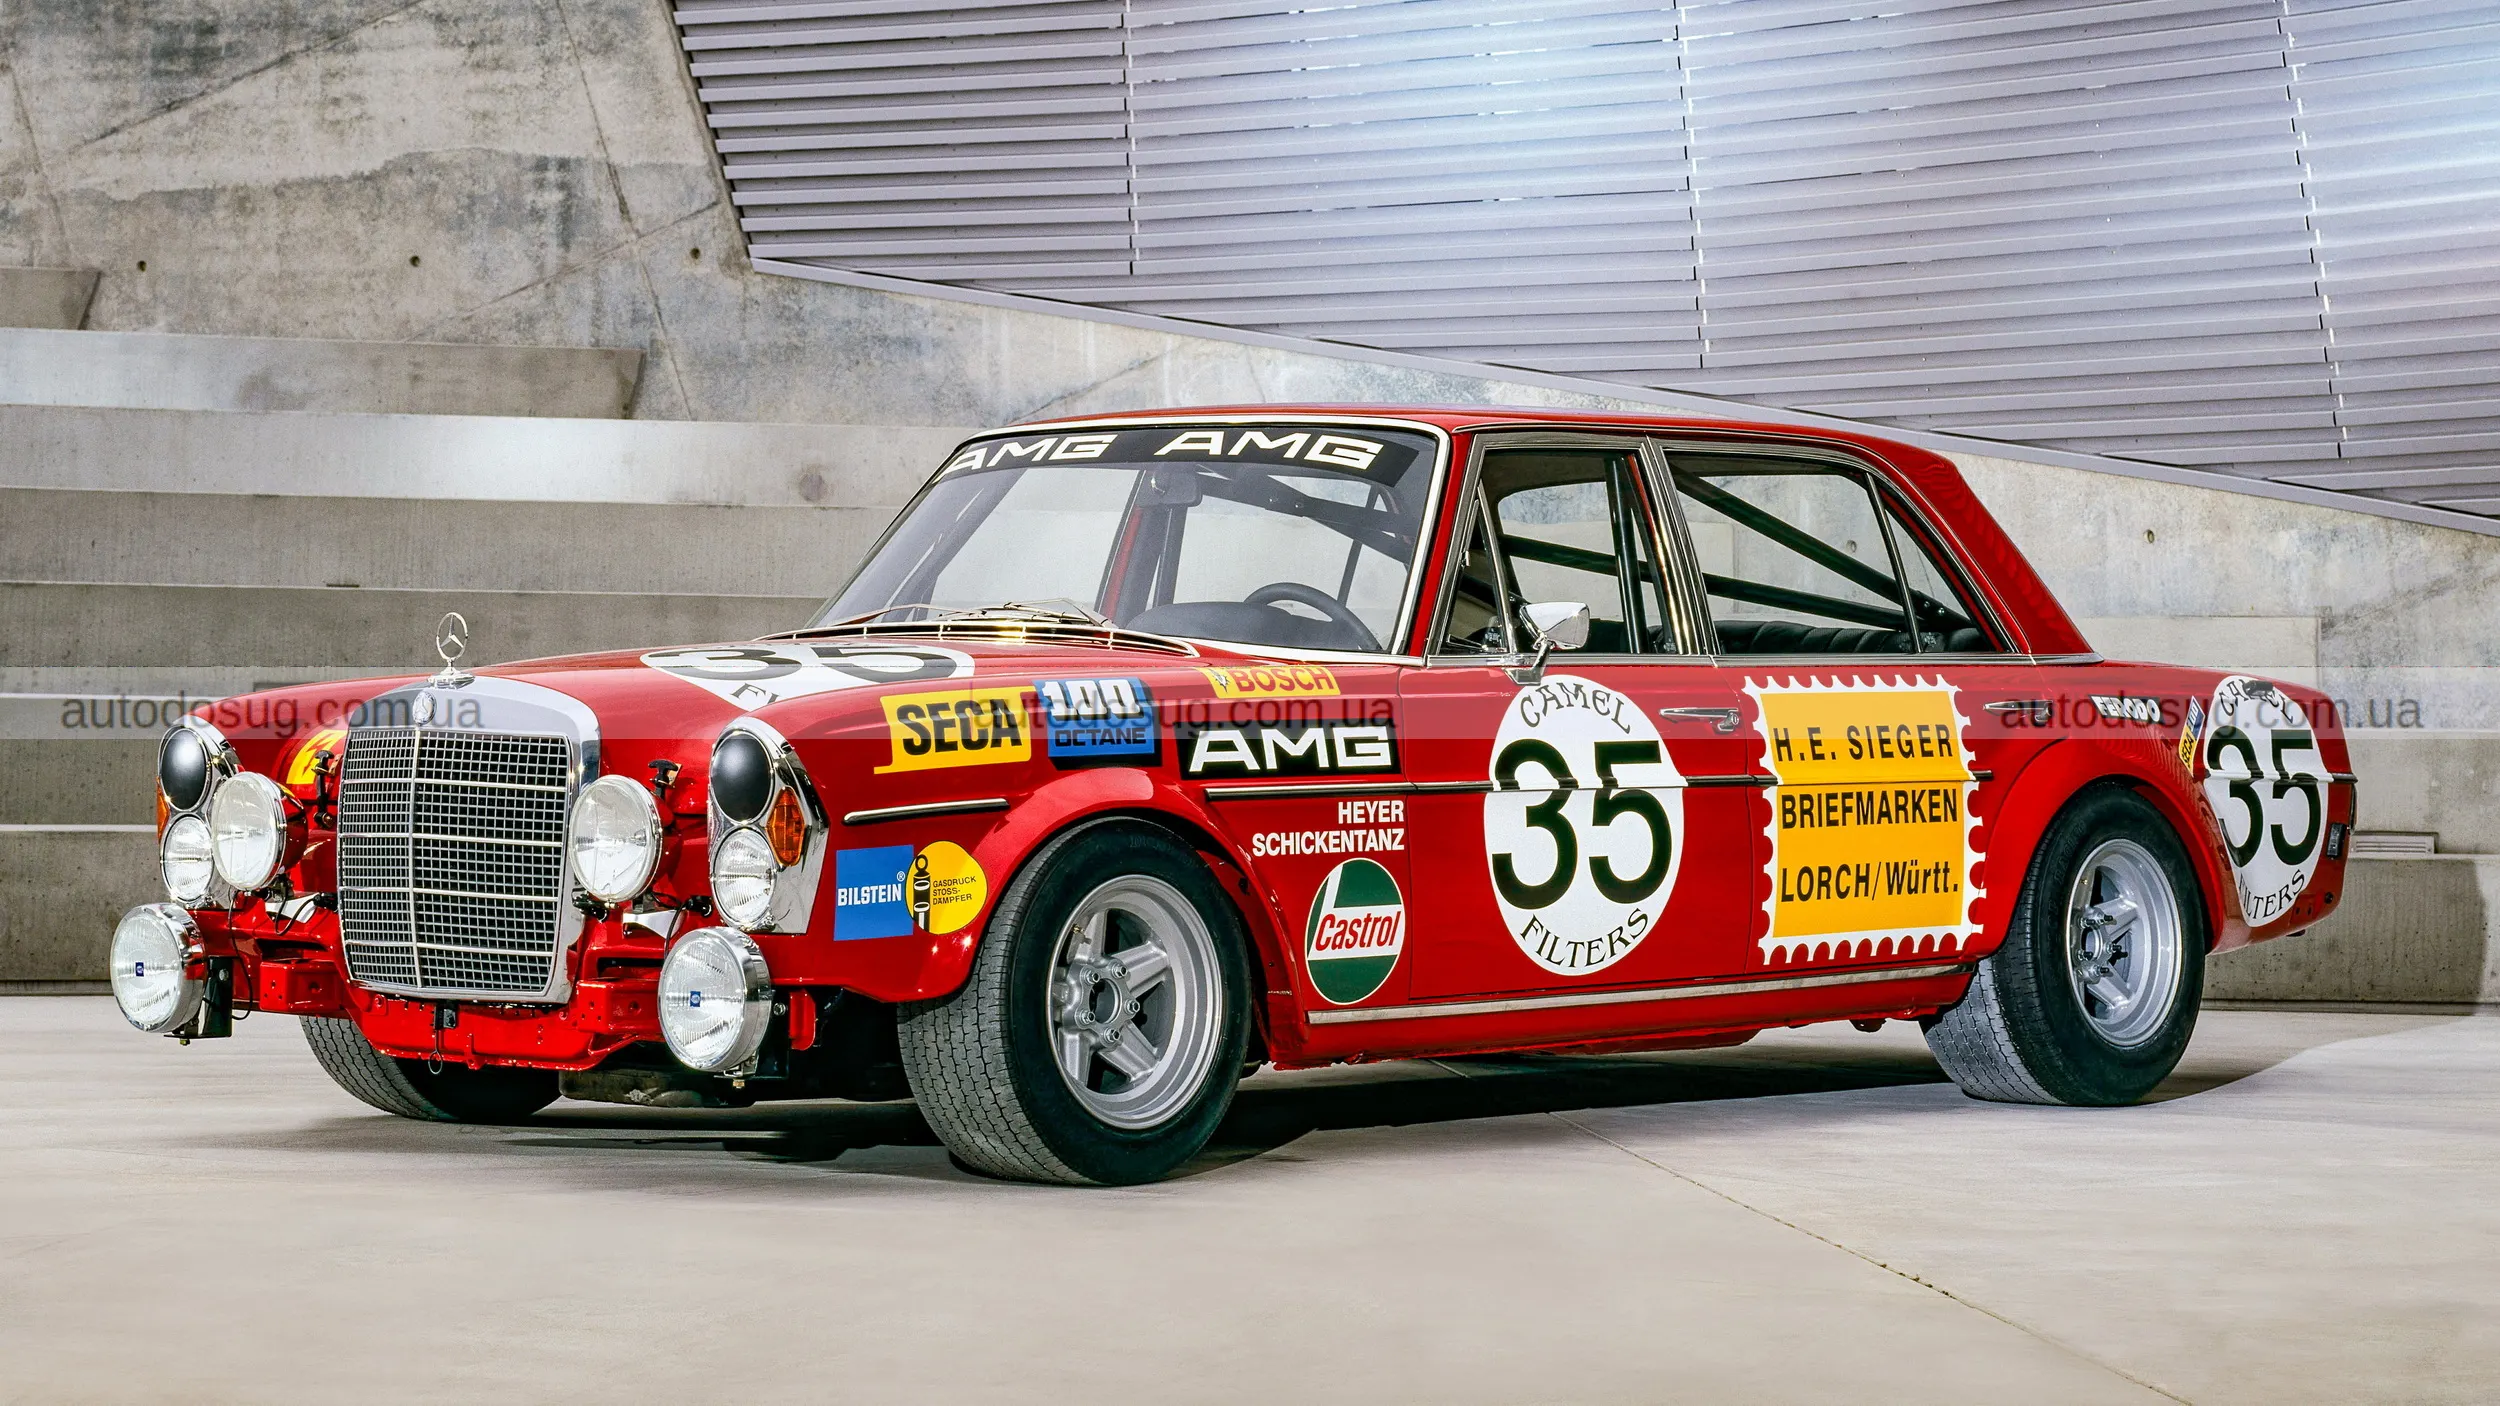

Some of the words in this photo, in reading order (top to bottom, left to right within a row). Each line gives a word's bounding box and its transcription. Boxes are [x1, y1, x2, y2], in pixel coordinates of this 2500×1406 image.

[932, 434, 1118, 484] AMG
[1154, 431, 1384, 470] AMG
[649, 645, 957, 684] 35
[1229, 667, 1334, 692] BOSCH
[1042, 680, 1141, 718] 100
[1520, 682, 1631, 734] CAMEL
[2090, 695, 2161, 722] FERODO
[896, 698, 1023, 756] SECA
[1055, 728, 1147, 747] OCTANE
[1773, 724, 1837, 762] H.E.
[1846, 723, 1953, 760] SIEGER
[1188, 726, 1392, 773] AMG
[1338, 800, 1405, 824] HEYER
[1781, 788, 1958, 829] BRIEFMARKEN
[2207, 726, 2321, 867] 35
[1252, 828, 1405, 857] SCHICKENTANZ
[1492, 738, 1672, 910] 35
[838, 883, 902, 907] BILSTEIN
[933, 876, 977, 888] GASDRUCK
[933, 887, 961, 897] STOSS-
[1781, 859, 1959, 902] LORCH/Württ.
[2239, 869, 2305, 919] FILTERS
[1315, 910, 1402, 951] Castrol
[1520, 908, 1649, 968] FILTERS
